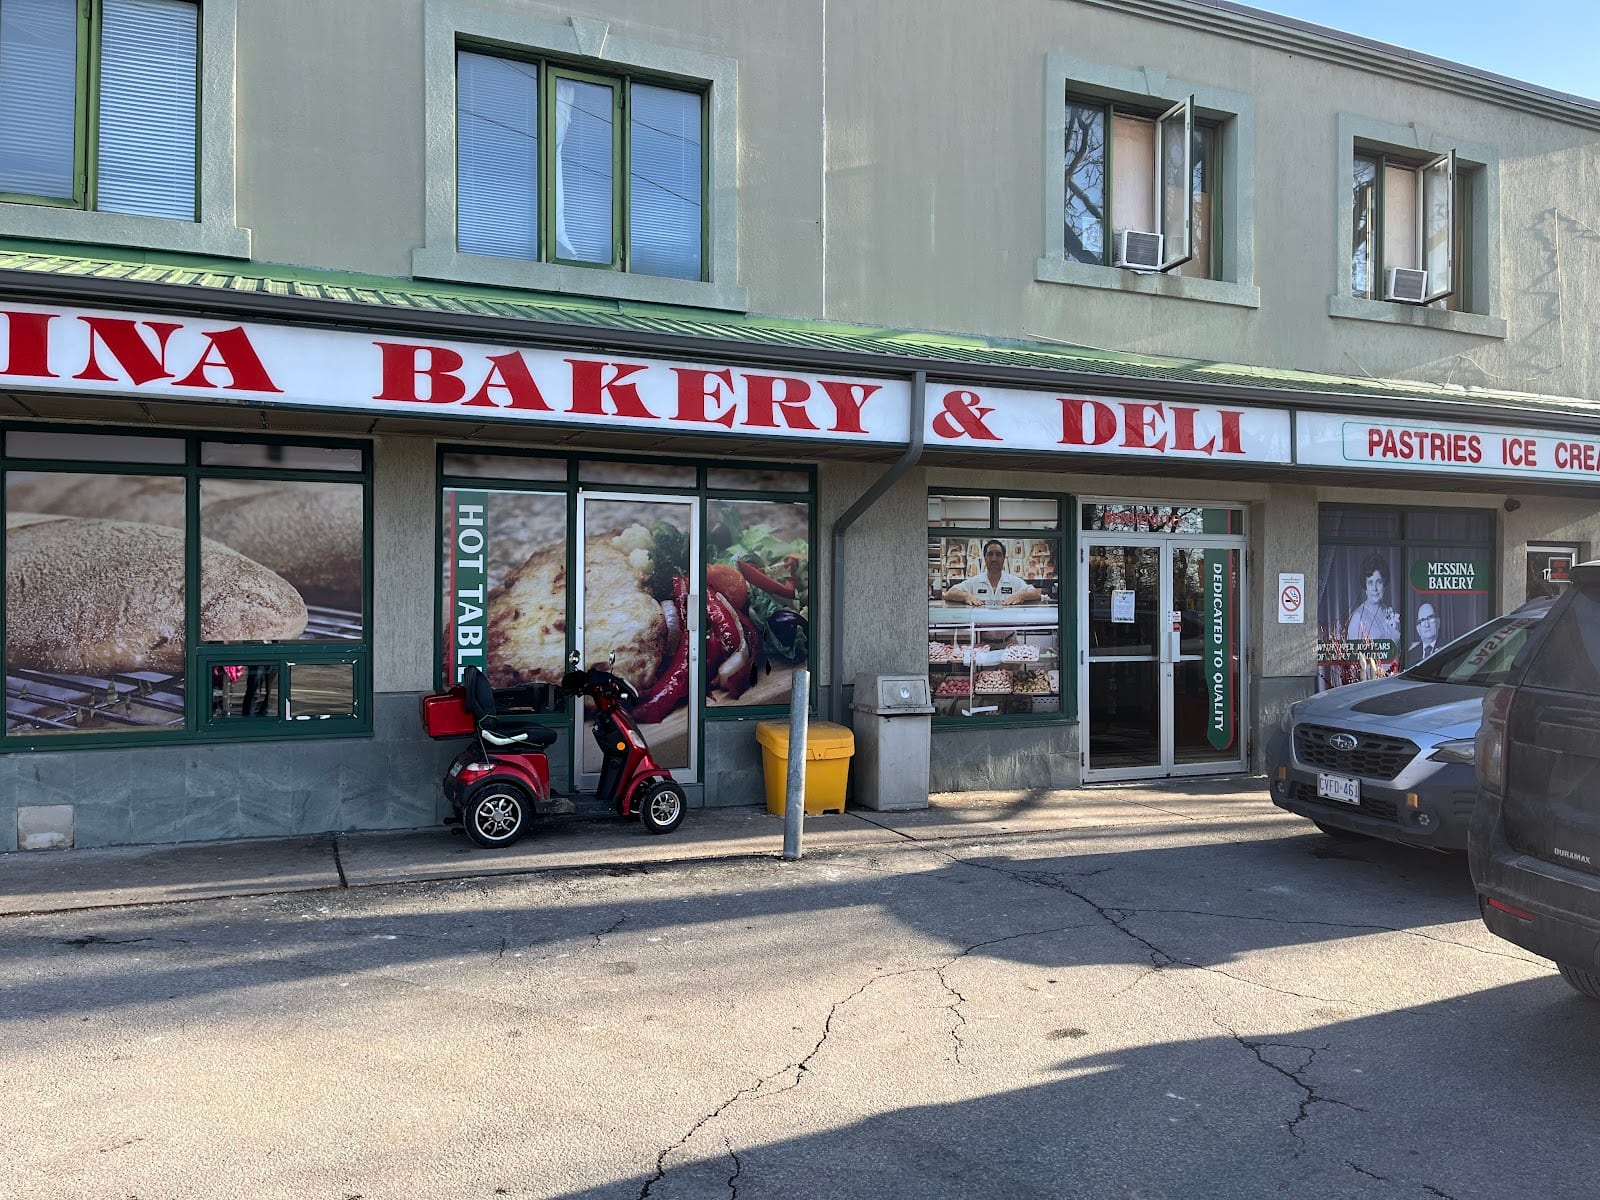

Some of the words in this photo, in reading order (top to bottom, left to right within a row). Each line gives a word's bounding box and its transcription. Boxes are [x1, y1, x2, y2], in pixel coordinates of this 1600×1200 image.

[0, 311, 284, 393] INA
[372, 341, 883, 434] BAKERY
[932, 390, 1003, 441] &
[1057, 398, 1246, 456] DELI
[1368, 428, 1482, 463] PASTRIES
[1502, 438, 1537, 467] ICE
[1555, 442, 1600, 471] CRE
[458, 504, 484, 574] HOT
[1428, 562, 1475, 576] MESSINA
[1428, 577, 1475, 590] BAKERY
[1213, 563, 1223, 645] DEDICATED
[1336, 642, 1354, 651] VER
[1370, 642, 1391, 650] YEARS
[1355, 651, 1388, 660] TADTION
[1213, 649, 1223, 667] TO
[1213, 672, 1224, 731] QUALITY
[1320, 777, 1339, 793] CVFD
[1344, 782, 1358, 798] 461
[1554, 847, 1591, 864] DURAMAX
